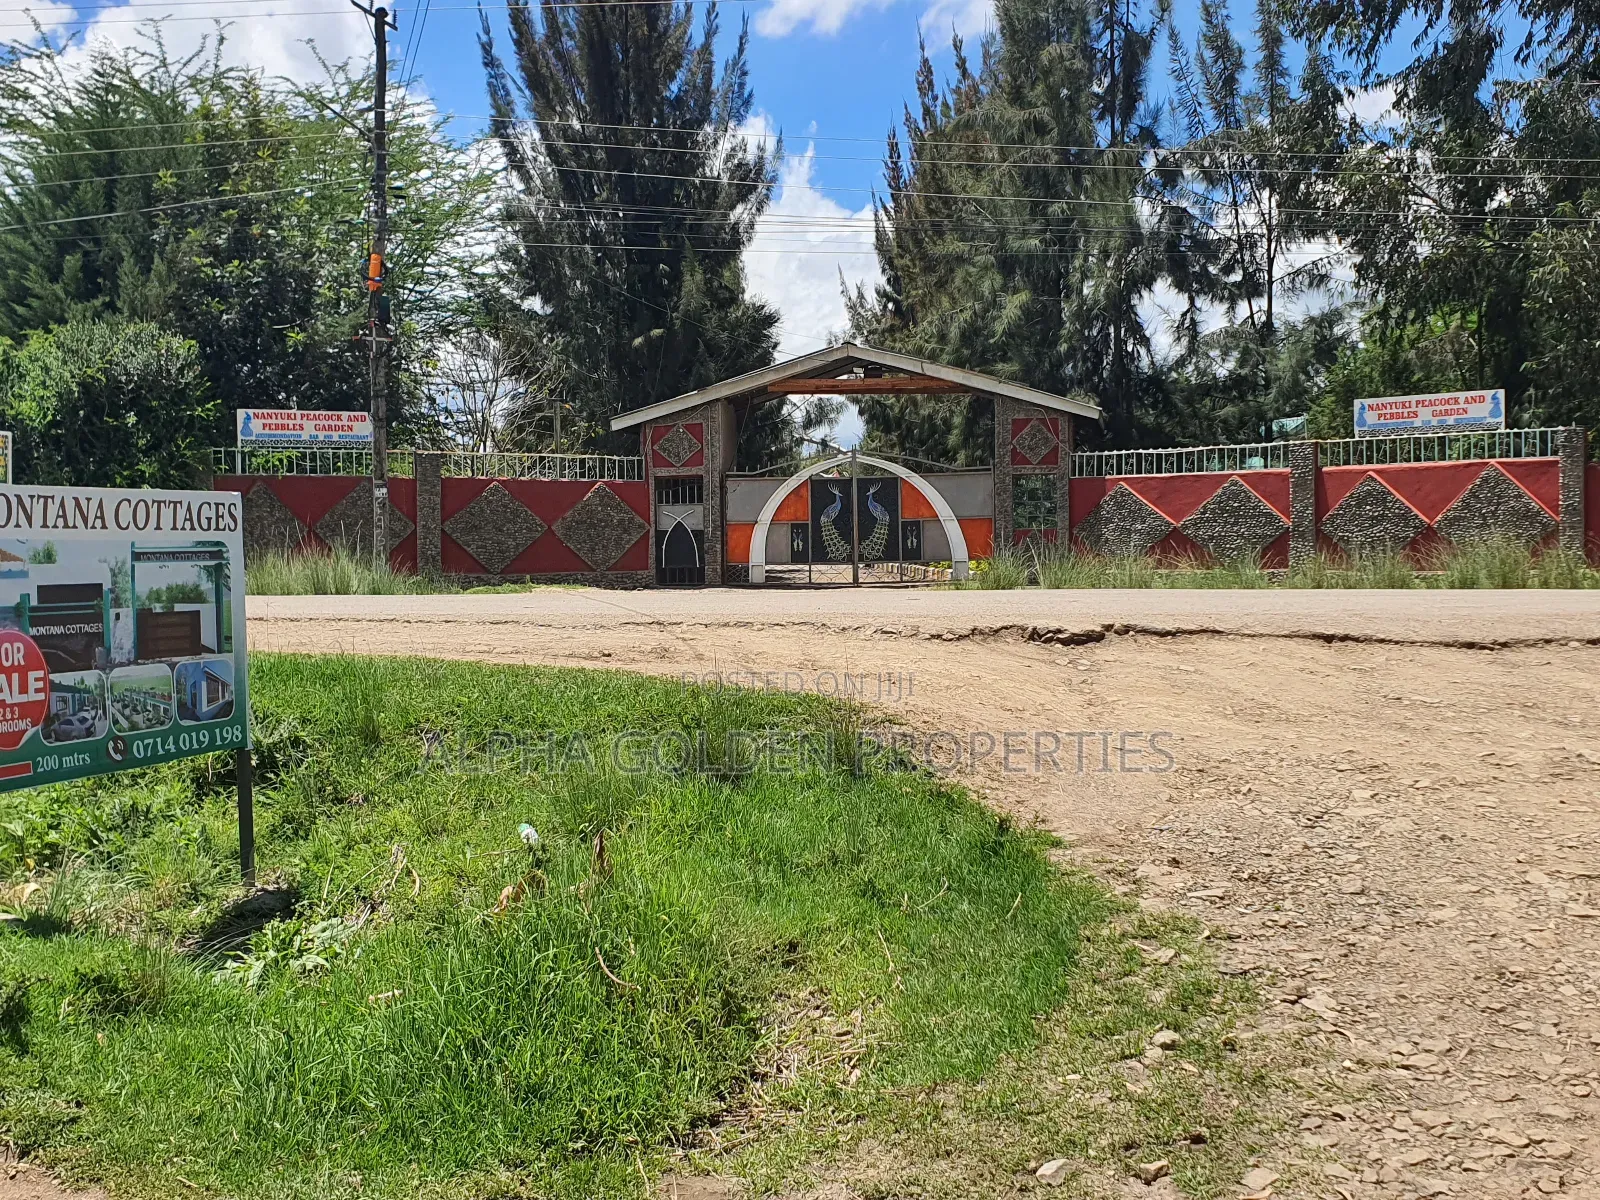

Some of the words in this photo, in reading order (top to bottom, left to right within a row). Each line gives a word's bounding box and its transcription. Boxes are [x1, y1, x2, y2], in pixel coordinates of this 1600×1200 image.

[1367, 401, 1412, 412] NANYUKI
[1415, 397, 1460, 408] PEACOCK
[1463, 395, 1486, 404] AND
[252, 411, 297, 421] NANYUKI
[300, 412, 343, 422] PEACOCK
[346, 414, 367, 423] AND
[1377, 411, 1418, 421] PEBBLES
[1431, 407, 1468, 418] GARDEN
[262, 422, 305, 431] PEBBLES
[314, 423, 354, 432] GARDEN
[113, 498, 239, 533] COTTAGES
[140, 553, 173, 561] MONTANA
[174, 553, 210, 561] COTTAGES
[29, 625, 65, 636] MONTANA
[65, 623, 104, 634] COTTAGES
[1, 642, 25, 668] OR
[5, 707, 12, 720] &
[13, 706, 19, 719] 3
[0, 717, 32, 734] ROOMS
[132, 735, 177, 759] 0714
[179, 729, 210, 751] 019
[214, 724, 243, 746] 198
[36, 754, 59, 772] 200
[62, 751, 91, 768] mtrs
